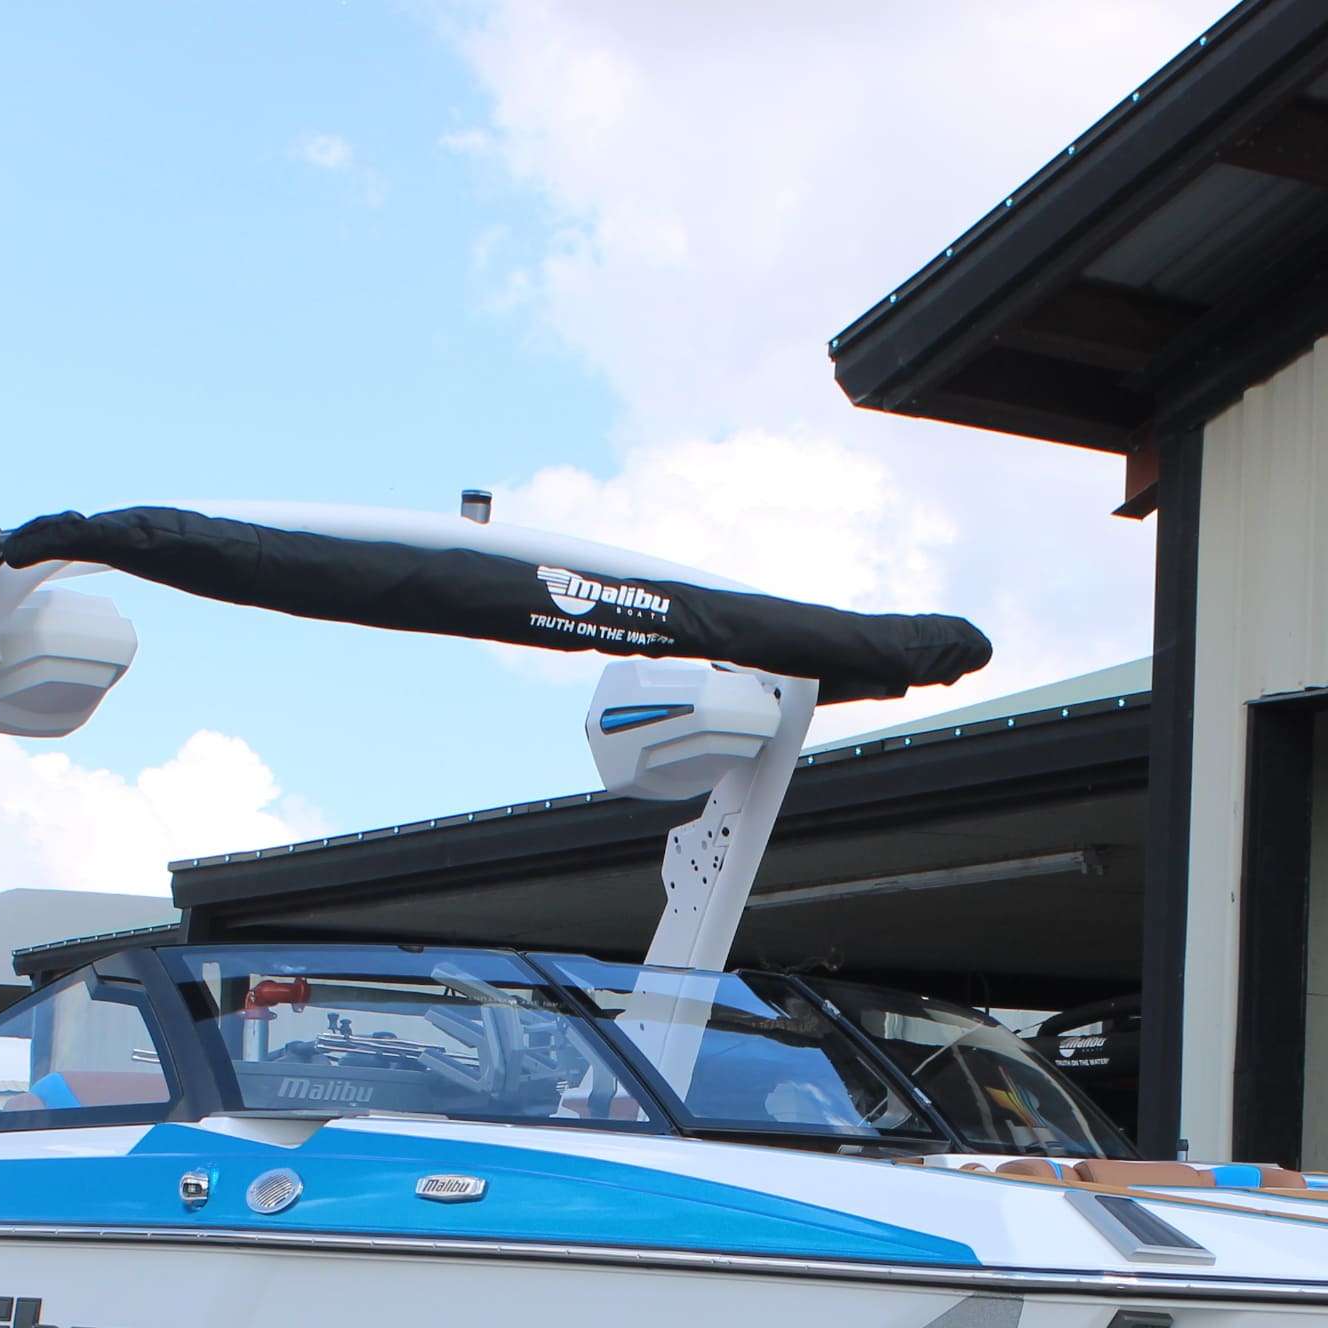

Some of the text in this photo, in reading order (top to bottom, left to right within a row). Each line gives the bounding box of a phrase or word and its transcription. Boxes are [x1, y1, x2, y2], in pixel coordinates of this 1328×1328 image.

[565, 576, 670, 614] Malibu
[529, 613, 574, 633] TRUTH
[577, 622, 598, 637] ON
[600, 625, 625, 641] THE
[616, 606, 667, 623] BOATS
[278, 1077, 373, 1103] Malibu
[422, 1179, 471, 1193] Malibu
